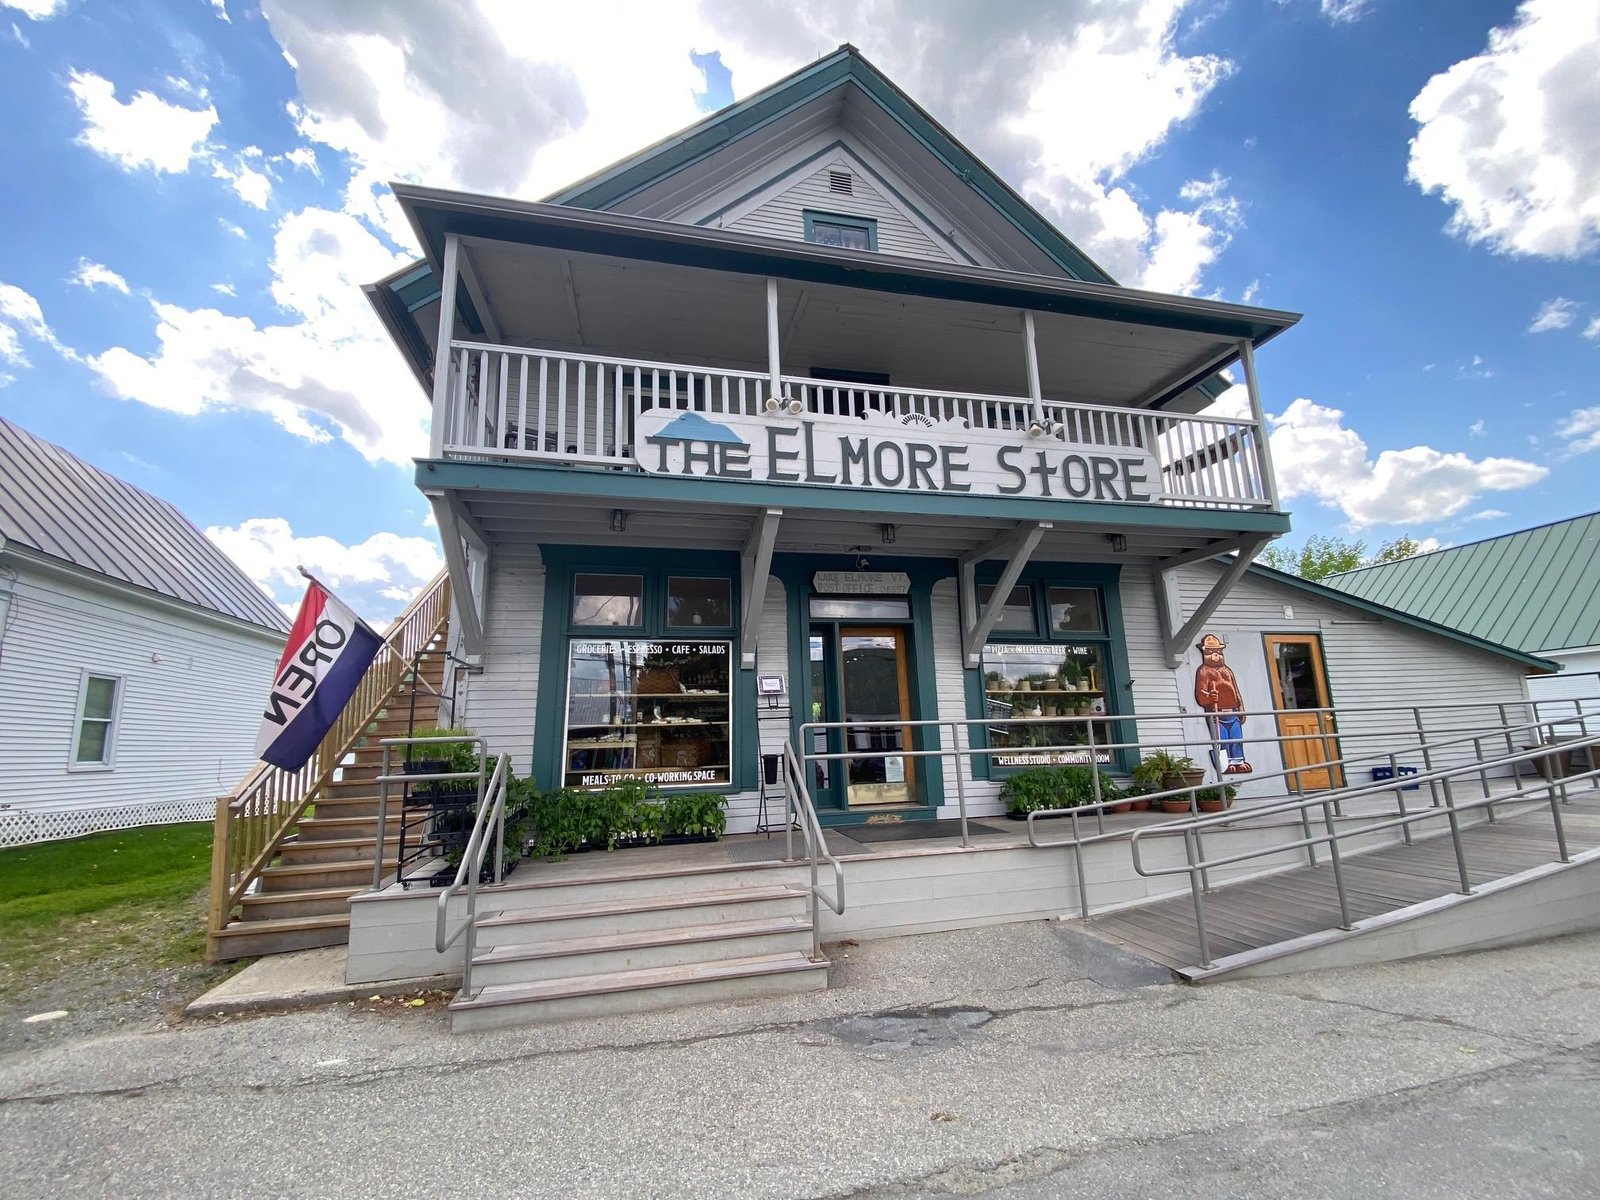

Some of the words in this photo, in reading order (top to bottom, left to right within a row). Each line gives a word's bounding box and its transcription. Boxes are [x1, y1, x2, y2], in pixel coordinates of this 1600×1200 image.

[645, 435, 752, 478] THE
[764, 421, 972, 492] ELMORE
[844, 573, 882, 582] ELMORE
[817, 582, 839, 592] POST
[843, 583, 874, 592] OFFICE
[576, 645, 618, 654] GROCERIES
[628, 645, 663, 654] ESPRESSO
[671, 645, 690, 654] CAFE
[698, 645, 726, 654] SALADS
[991, 645, 1008, 654] PIZZA
[1051, 645, 1066, 654] BEER
[1072, 646, 1088, 655] WINE
[998, 756, 1029, 765] WELLNESS
[1029, 755, 1051, 764] STUDIO
[582, 773, 635, 786] MEALS-TOO
[644, 771, 693, 783] CO-WORKING
[693, 770, 716, 781] SPACE
